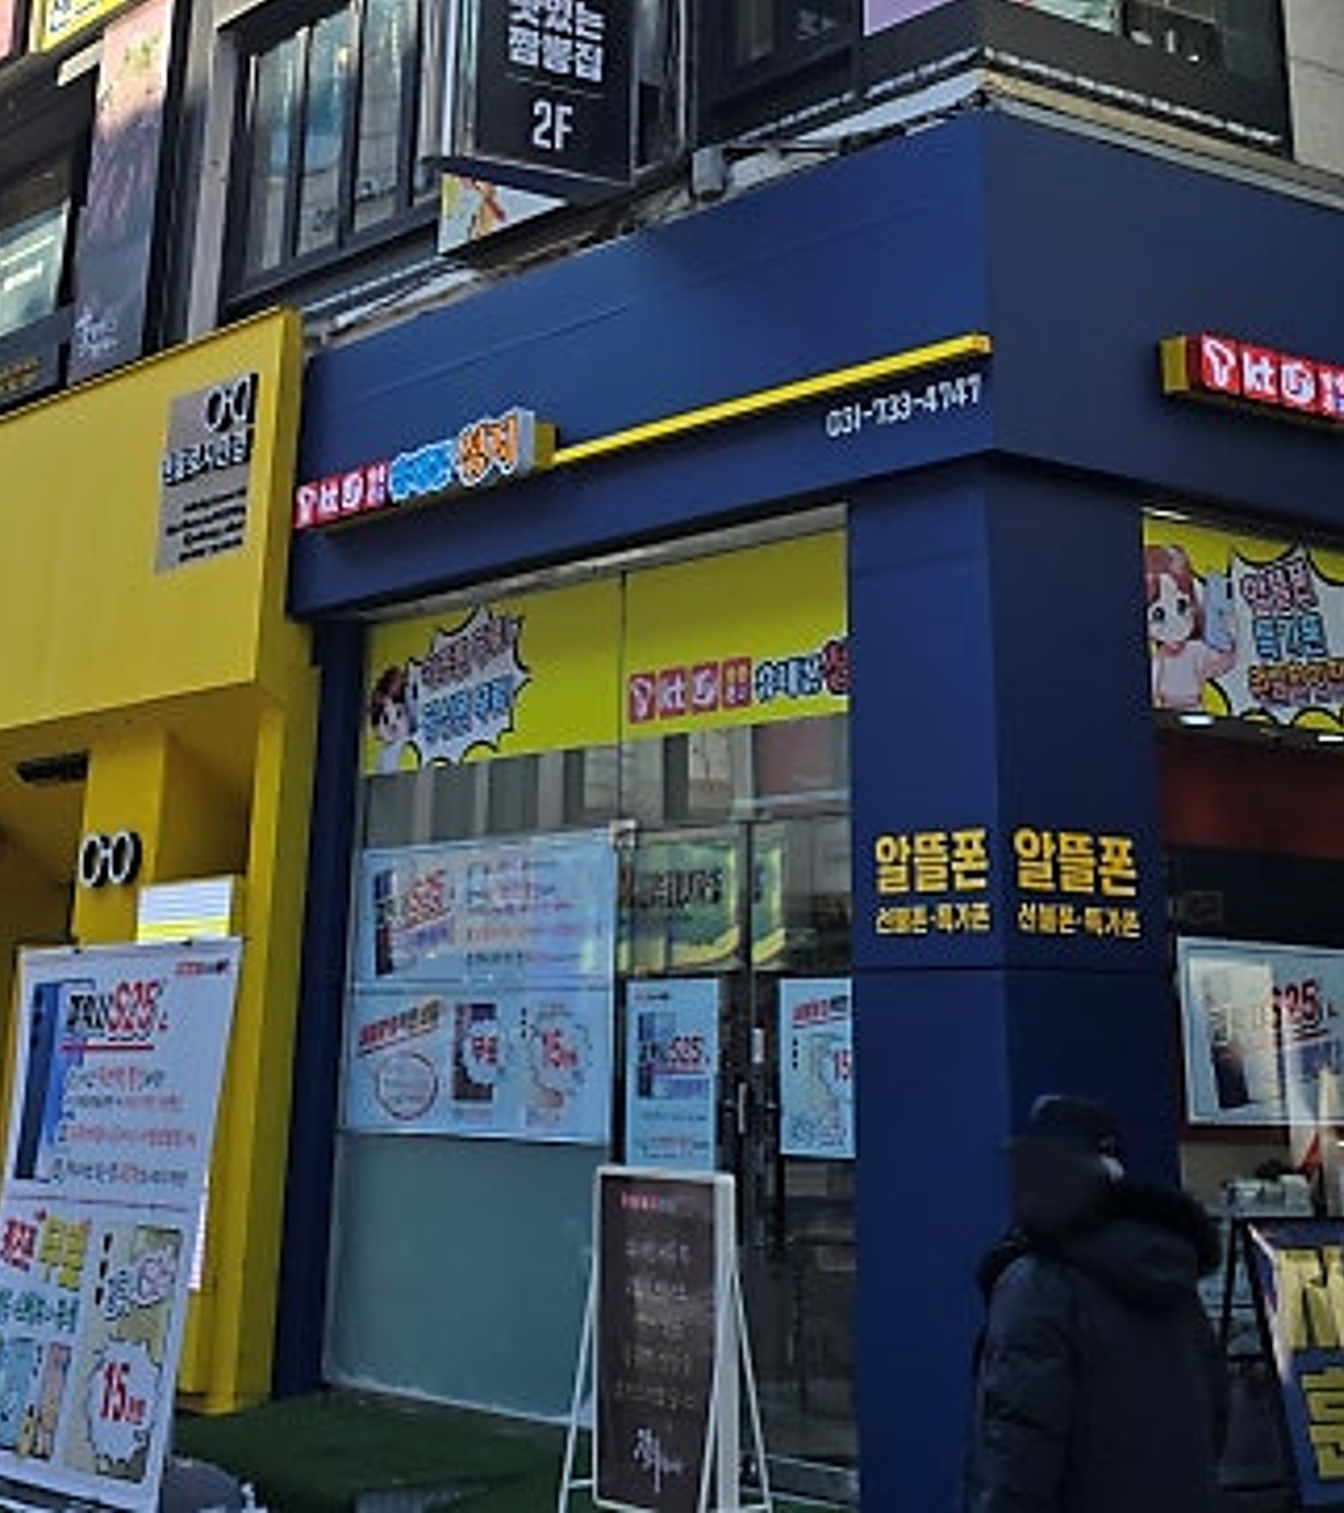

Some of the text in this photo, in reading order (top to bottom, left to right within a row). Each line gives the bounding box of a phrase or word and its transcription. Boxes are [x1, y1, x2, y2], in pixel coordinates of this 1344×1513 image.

[531, 99, 574, 151] 2F
[873, 826, 1138, 897] 알뜰폰 알뜰폰
